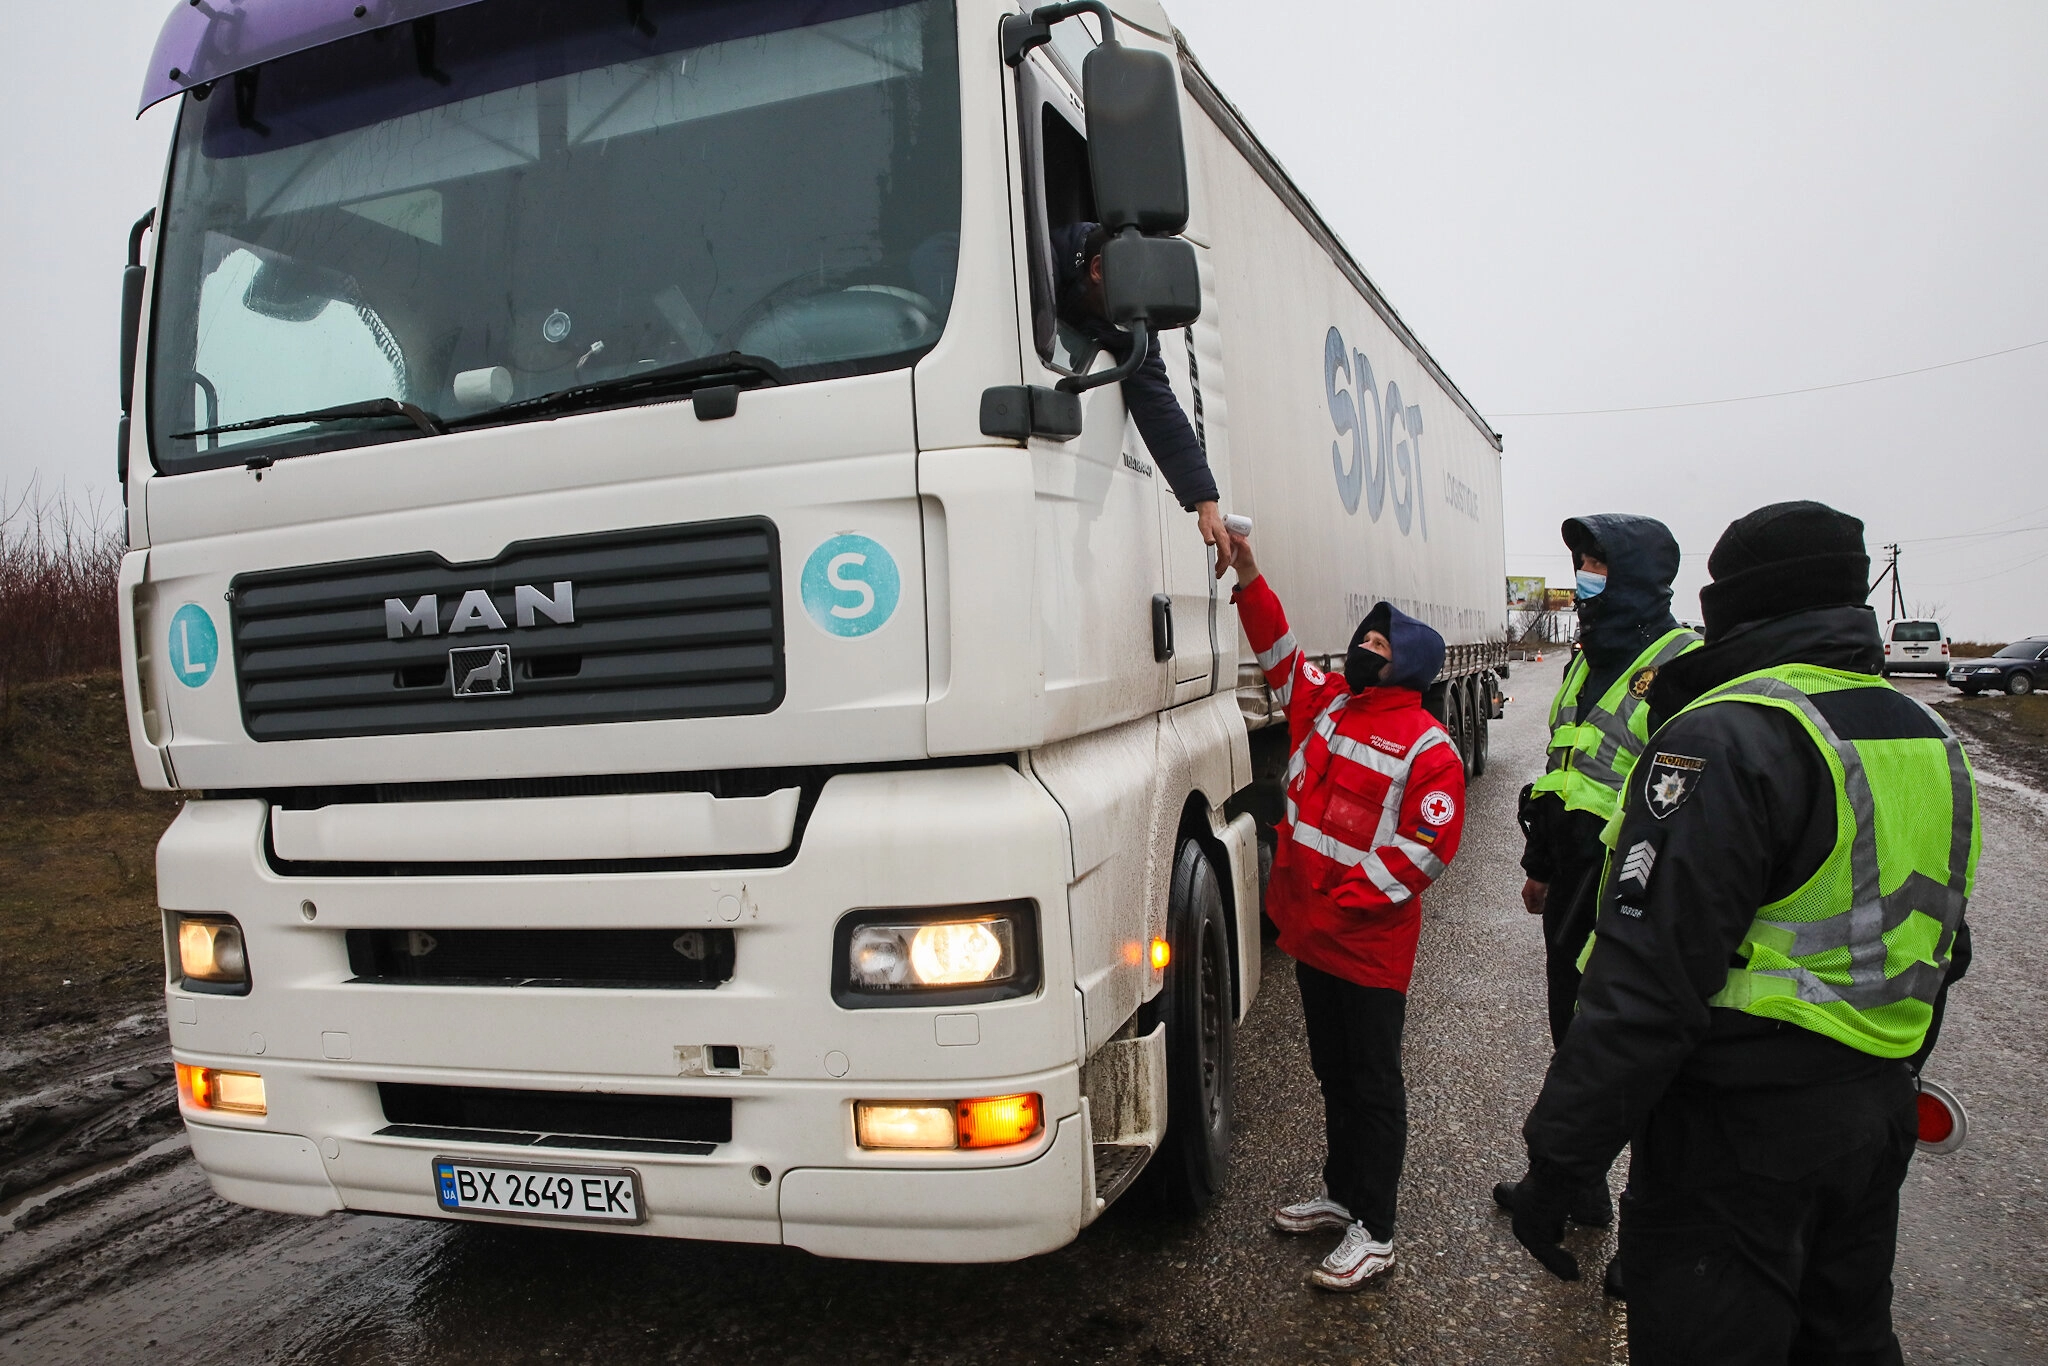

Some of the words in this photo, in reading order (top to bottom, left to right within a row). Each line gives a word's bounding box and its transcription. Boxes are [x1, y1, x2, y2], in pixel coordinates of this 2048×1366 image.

[1324, 325, 1428, 543] SDGT
[384, 580, 576, 640] MAN
[826, 551, 876, 620] S
[180, 620, 206, 669] L
[1658, 754, 1702, 769] ПОЛІЦІЯ
[443, 1189, 457, 1201] UA
[457, 1169, 501, 1204] BX
[505, 1173, 574, 1210] 2649
[581, 1178, 629, 1213] EK
